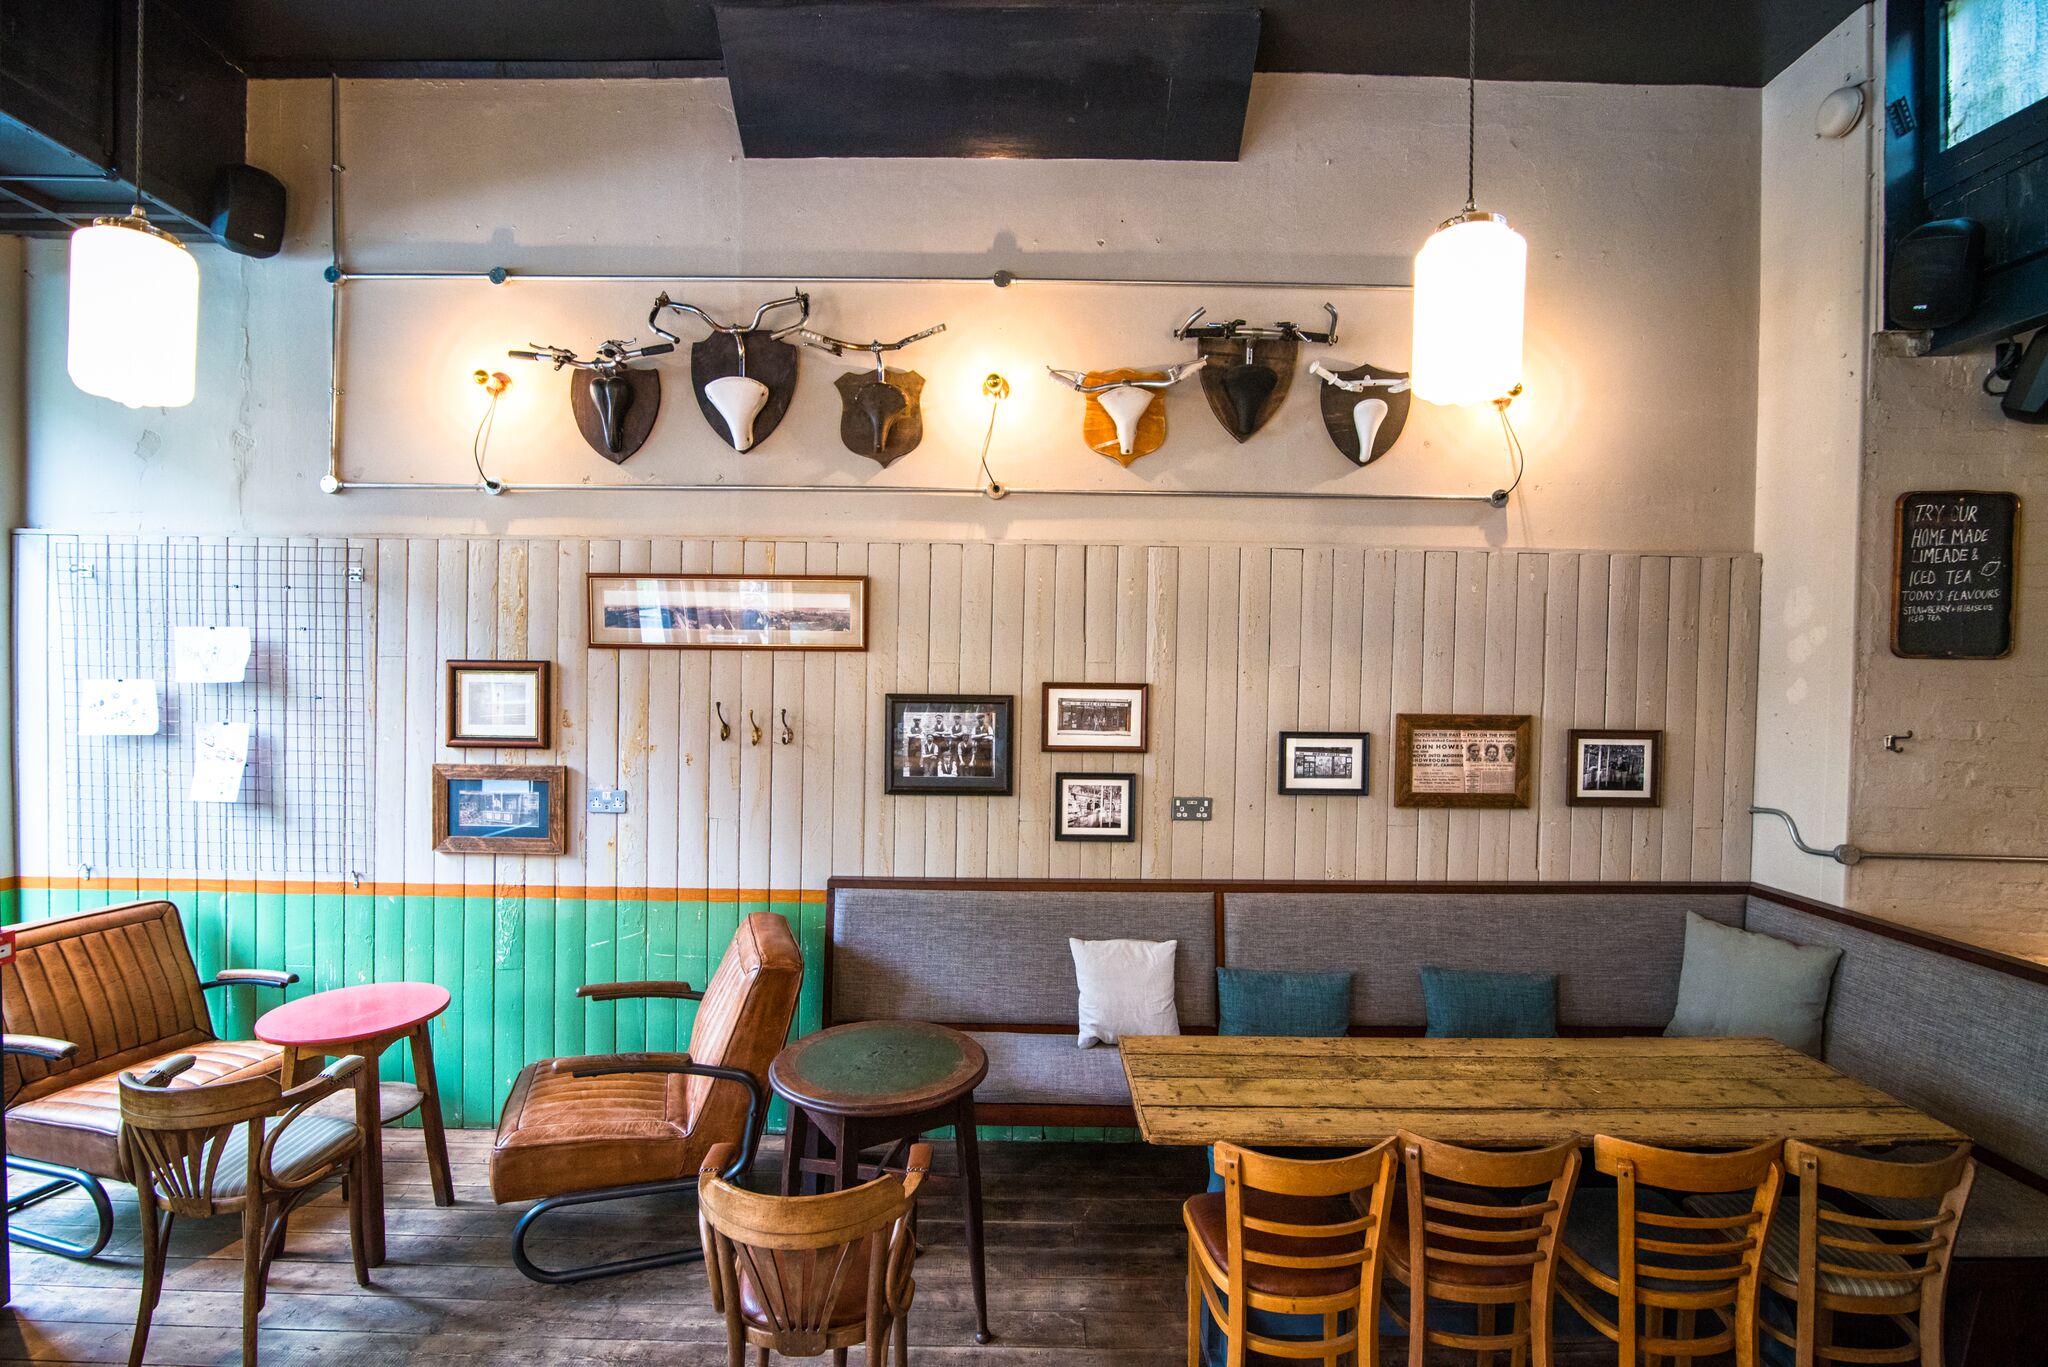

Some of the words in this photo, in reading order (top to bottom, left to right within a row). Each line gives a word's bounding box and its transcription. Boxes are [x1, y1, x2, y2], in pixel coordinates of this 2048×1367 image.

[1915, 504, 1946, 522] TRY
[1951, 505, 1978, 522] OUR
[1911, 528, 1946, 548] HOME
[1951, 528, 1990, 545] MADE
[1912, 547, 1969, 563] LIMEADE
[1971, 548, 1979, 561] &
[1909, 569, 1936, 587] ICED
[1945, 569, 1972, 585] TEA
[1902, 590, 1944, 601] TODAY'S
